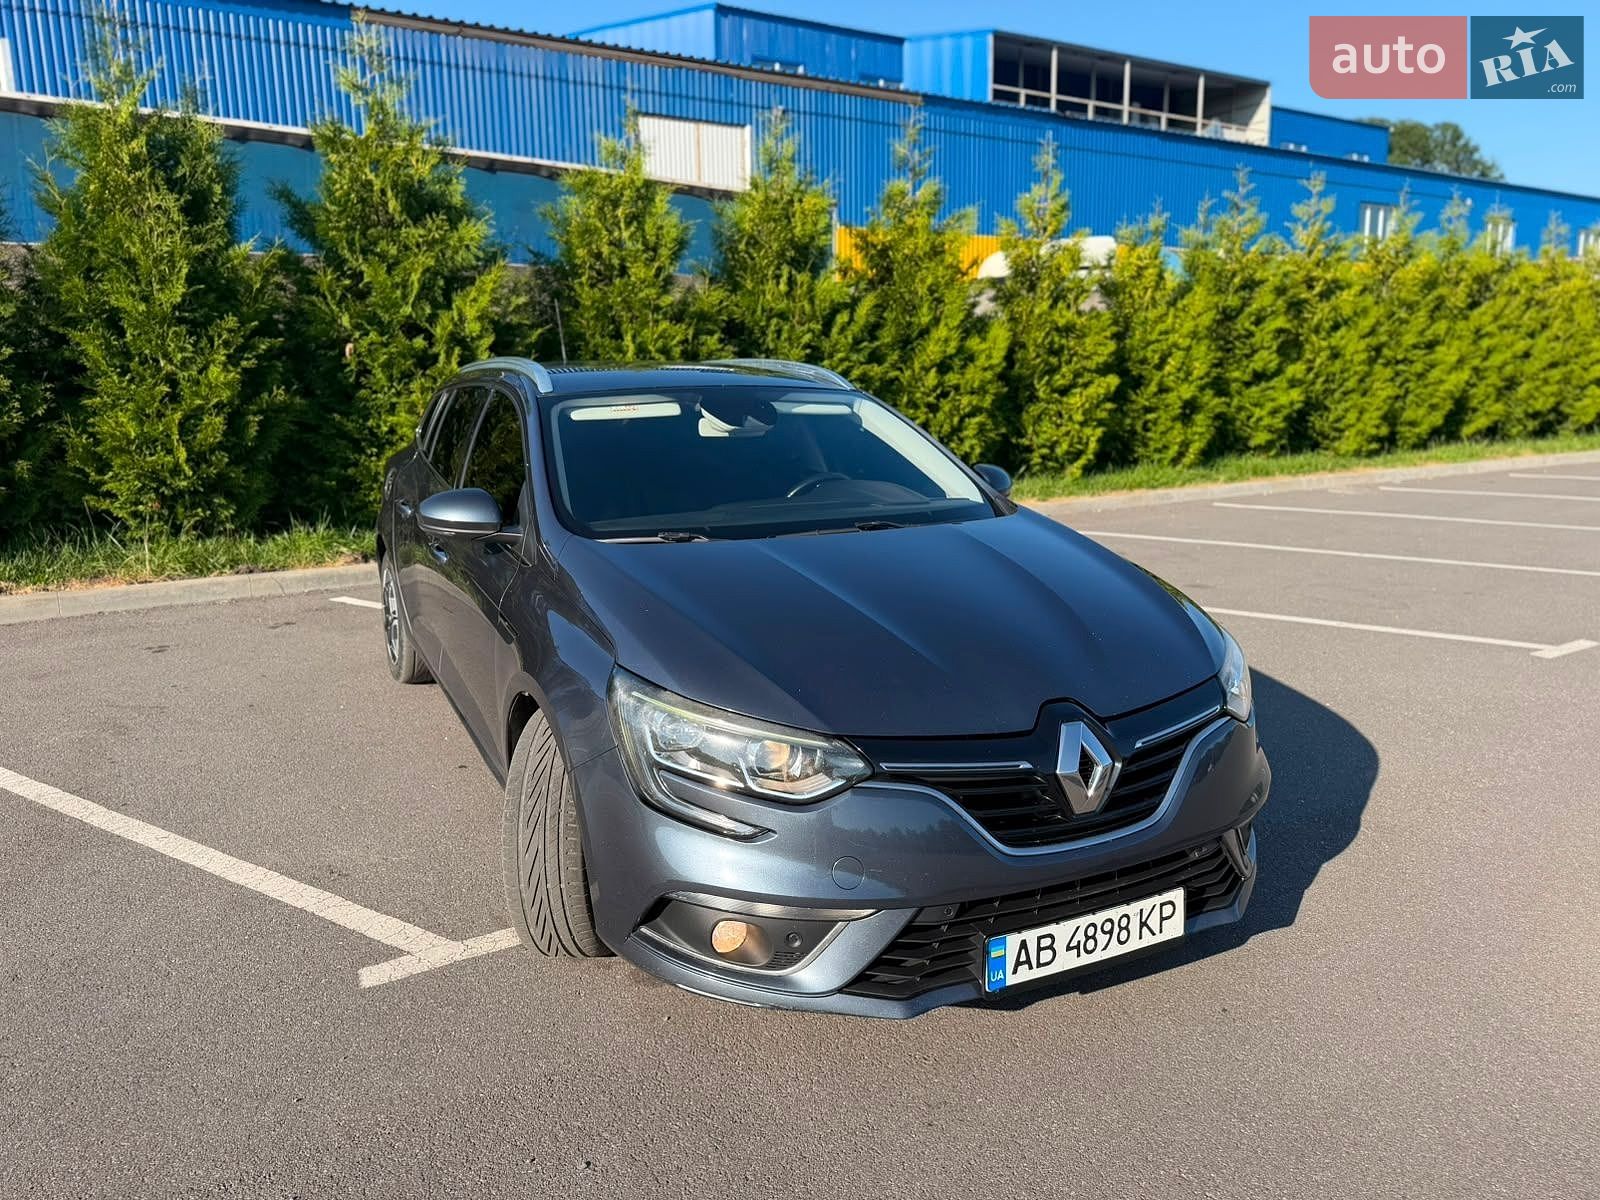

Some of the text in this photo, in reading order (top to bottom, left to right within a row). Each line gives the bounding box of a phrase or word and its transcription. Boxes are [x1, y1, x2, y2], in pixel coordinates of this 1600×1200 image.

[1011, 899, 1177, 976] AB 4898 KP
[990, 970, 1005, 982] UA
